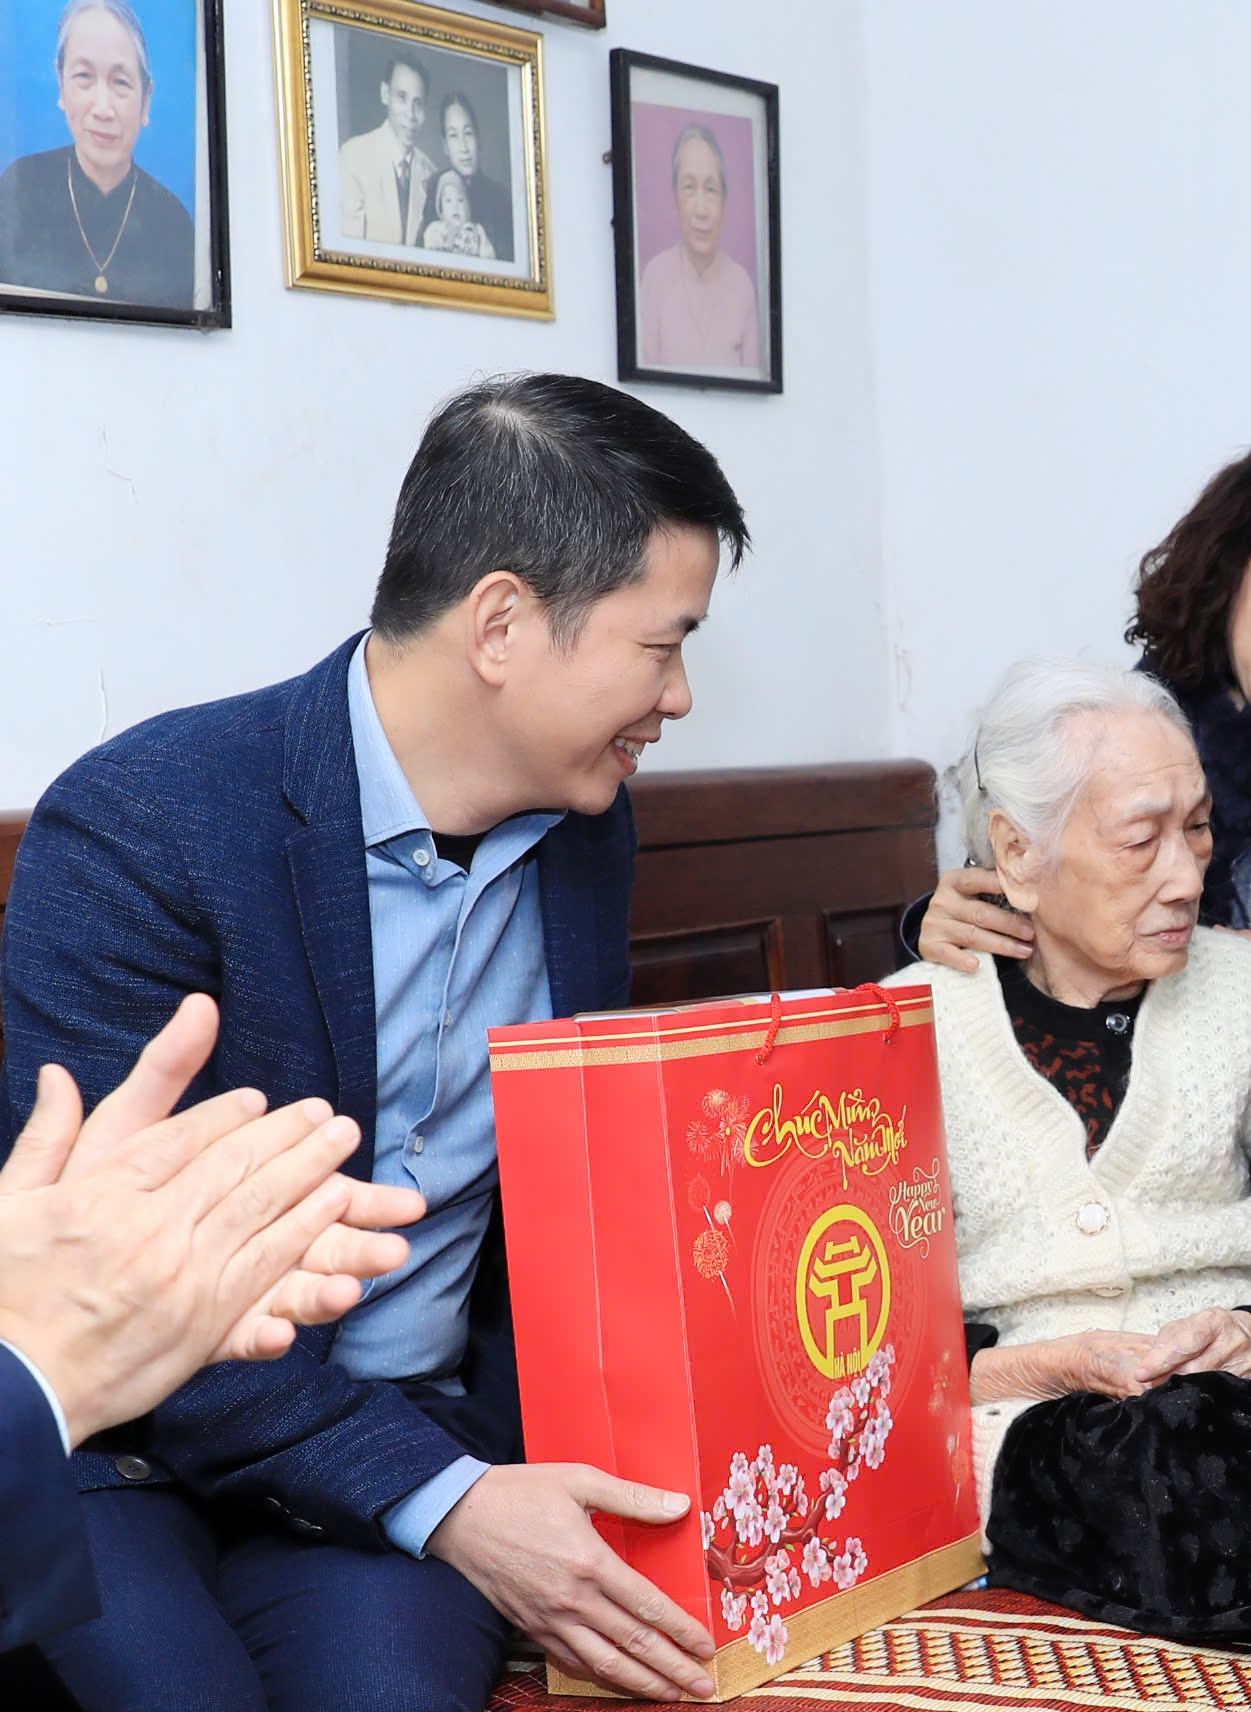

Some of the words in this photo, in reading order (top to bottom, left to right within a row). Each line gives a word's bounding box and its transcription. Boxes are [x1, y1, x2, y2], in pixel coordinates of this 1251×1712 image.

[744, 1083, 831, 1167] Chúc
[833, 1128, 884, 1190] Năm
[894, 1200, 946, 1246] Year
[834, 1352, 846, 1379] HÀ
